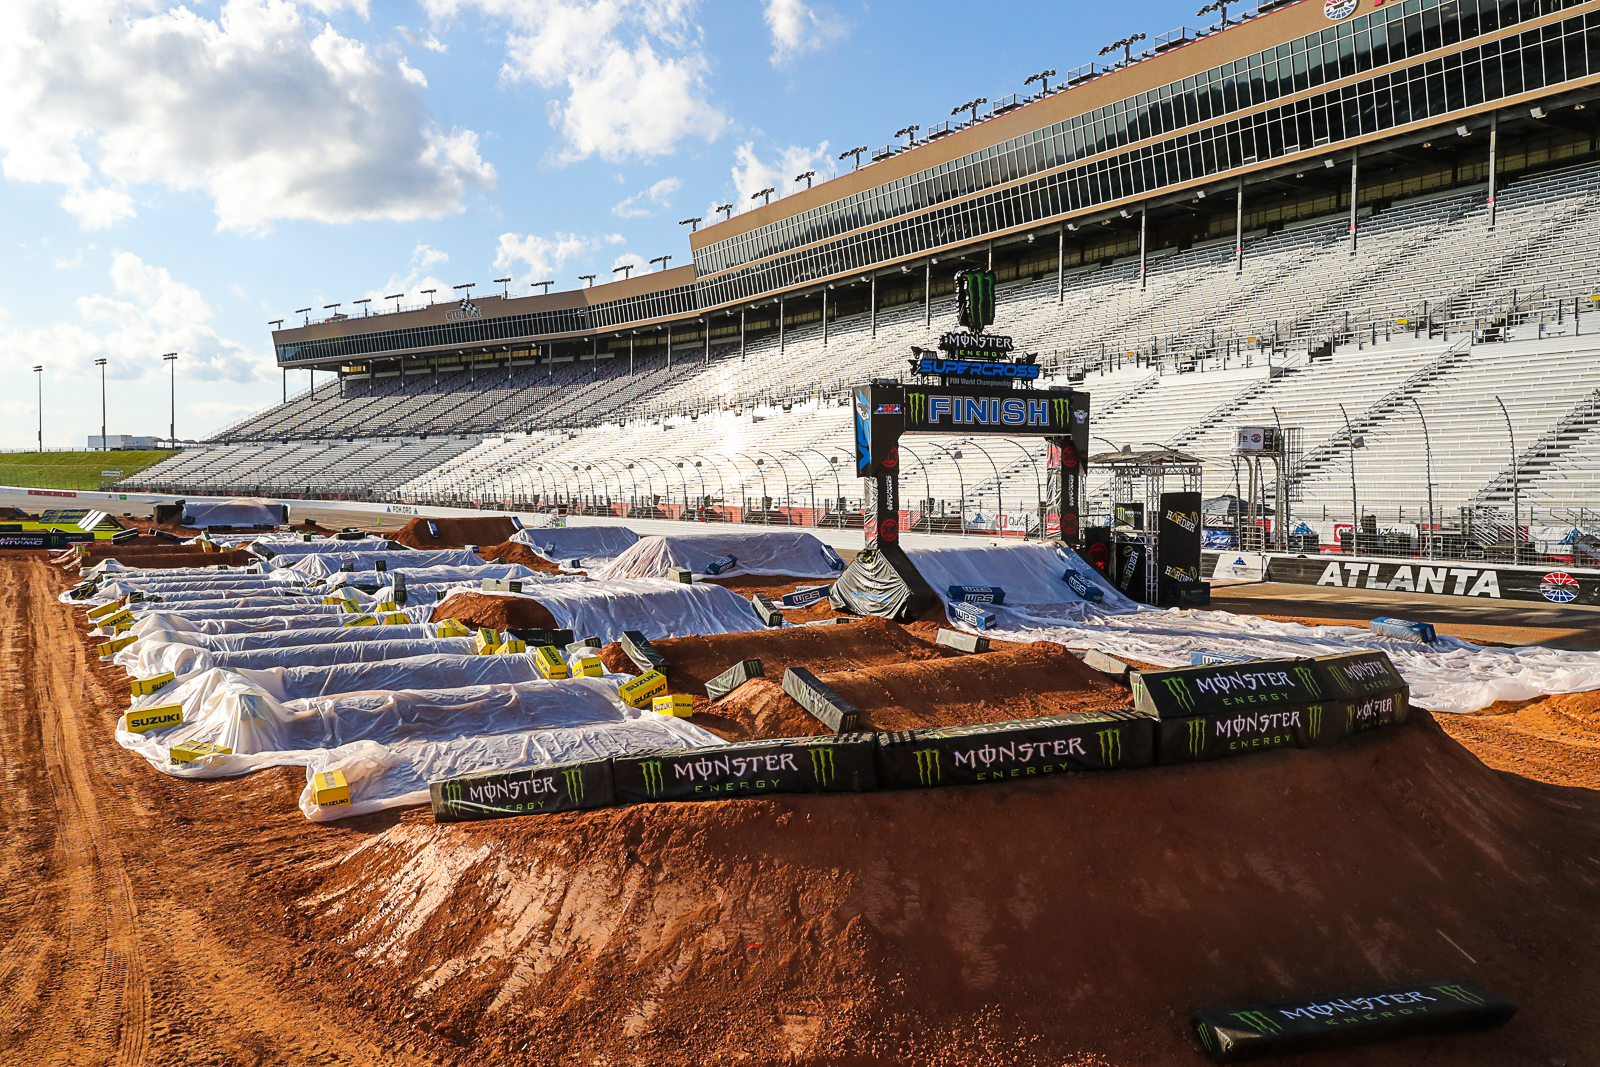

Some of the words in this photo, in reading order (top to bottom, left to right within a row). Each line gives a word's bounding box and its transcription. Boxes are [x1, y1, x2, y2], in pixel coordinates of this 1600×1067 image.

[445, 309, 465, 321] CLUB
[949, 334, 1013, 350] MONSTER
[960, 349, 1005, 357] ENERGY
[920, 360, 1039, 377] SUPERCROSS
[976, 379, 1012, 388] Championship
[874, 404, 902, 414] AMA
[928, 395, 1050, 427] FINISH
[1069, 576, 1087, 596] WPS
[1316, 561, 1501, 598] ATLANTA
[793, 591, 820, 604] WPS
[964, 594, 994, 603] WPS
[955, 608, 977, 627] WPS
[544, 646, 562, 666] SUZUKI
[1343, 660, 1389, 681] MONSTER
[625, 672, 660, 692] SUZUKI
[1195, 671, 1296, 695] MONSTER
[633, 683, 667, 706] SUZUKI
[1223, 692, 1290, 706] ENERGY
[653, 700, 673, 712] SUZUKI
[131, 713, 180, 728] SUZUKI
[1216, 711, 1302, 738] MONSTER
[1230, 735, 1291, 750] ENERGY
[954, 737, 1086, 769] MONSTER
[673, 753, 799, 781] MONSTER
[977, 763, 1069, 781] ENERGY
[469, 776, 558, 803] MONSTER
[694, 779, 780, 793] ENERGY
[482, 801, 545, 814] ENERGY
[1280, 990, 1438, 1020] MONSTER
[1324, 1006, 1429, 1026] ENERGY
